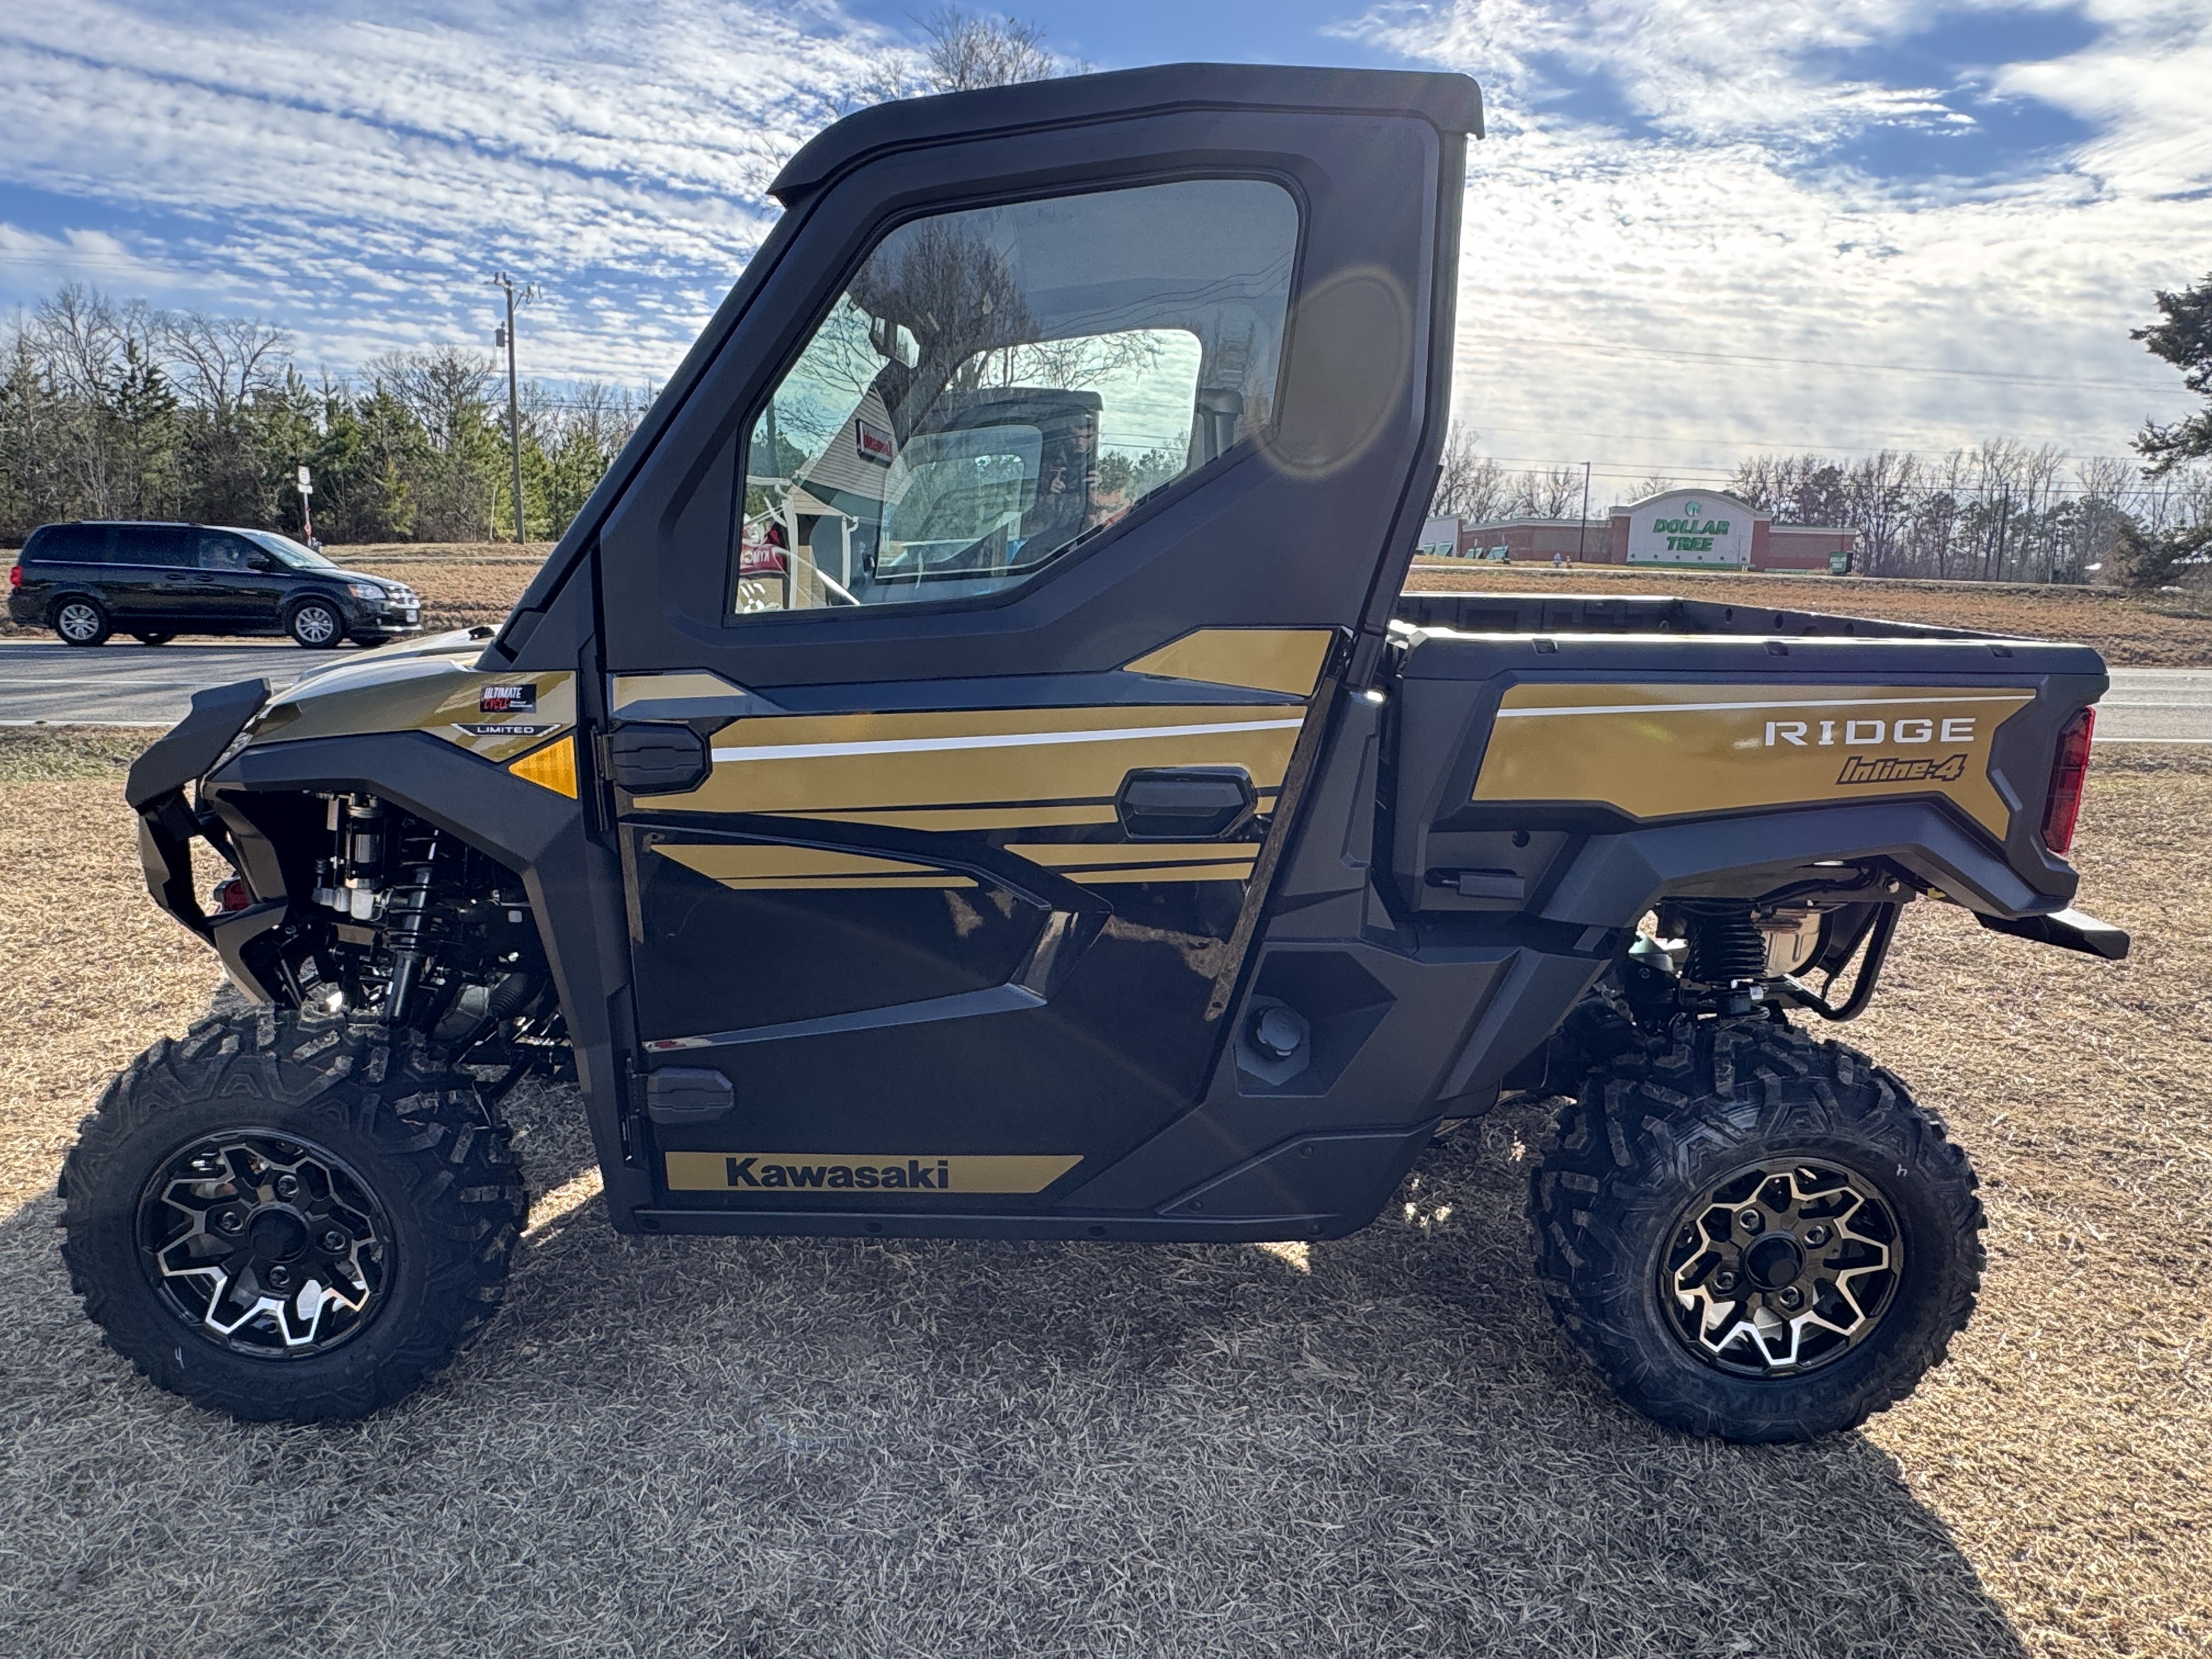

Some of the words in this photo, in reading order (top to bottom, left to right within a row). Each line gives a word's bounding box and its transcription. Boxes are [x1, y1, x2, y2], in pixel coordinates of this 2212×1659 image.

[1652, 518, 1730, 535] DOLLAR
[1666, 536, 1715, 551] TREE
[484, 687, 523, 698] ULTIMATE
[1765, 718, 1976, 746] RIDGE
[1835, 753, 1968, 785] Inline-4
[725, 1158, 949, 1188] Kawasaki
